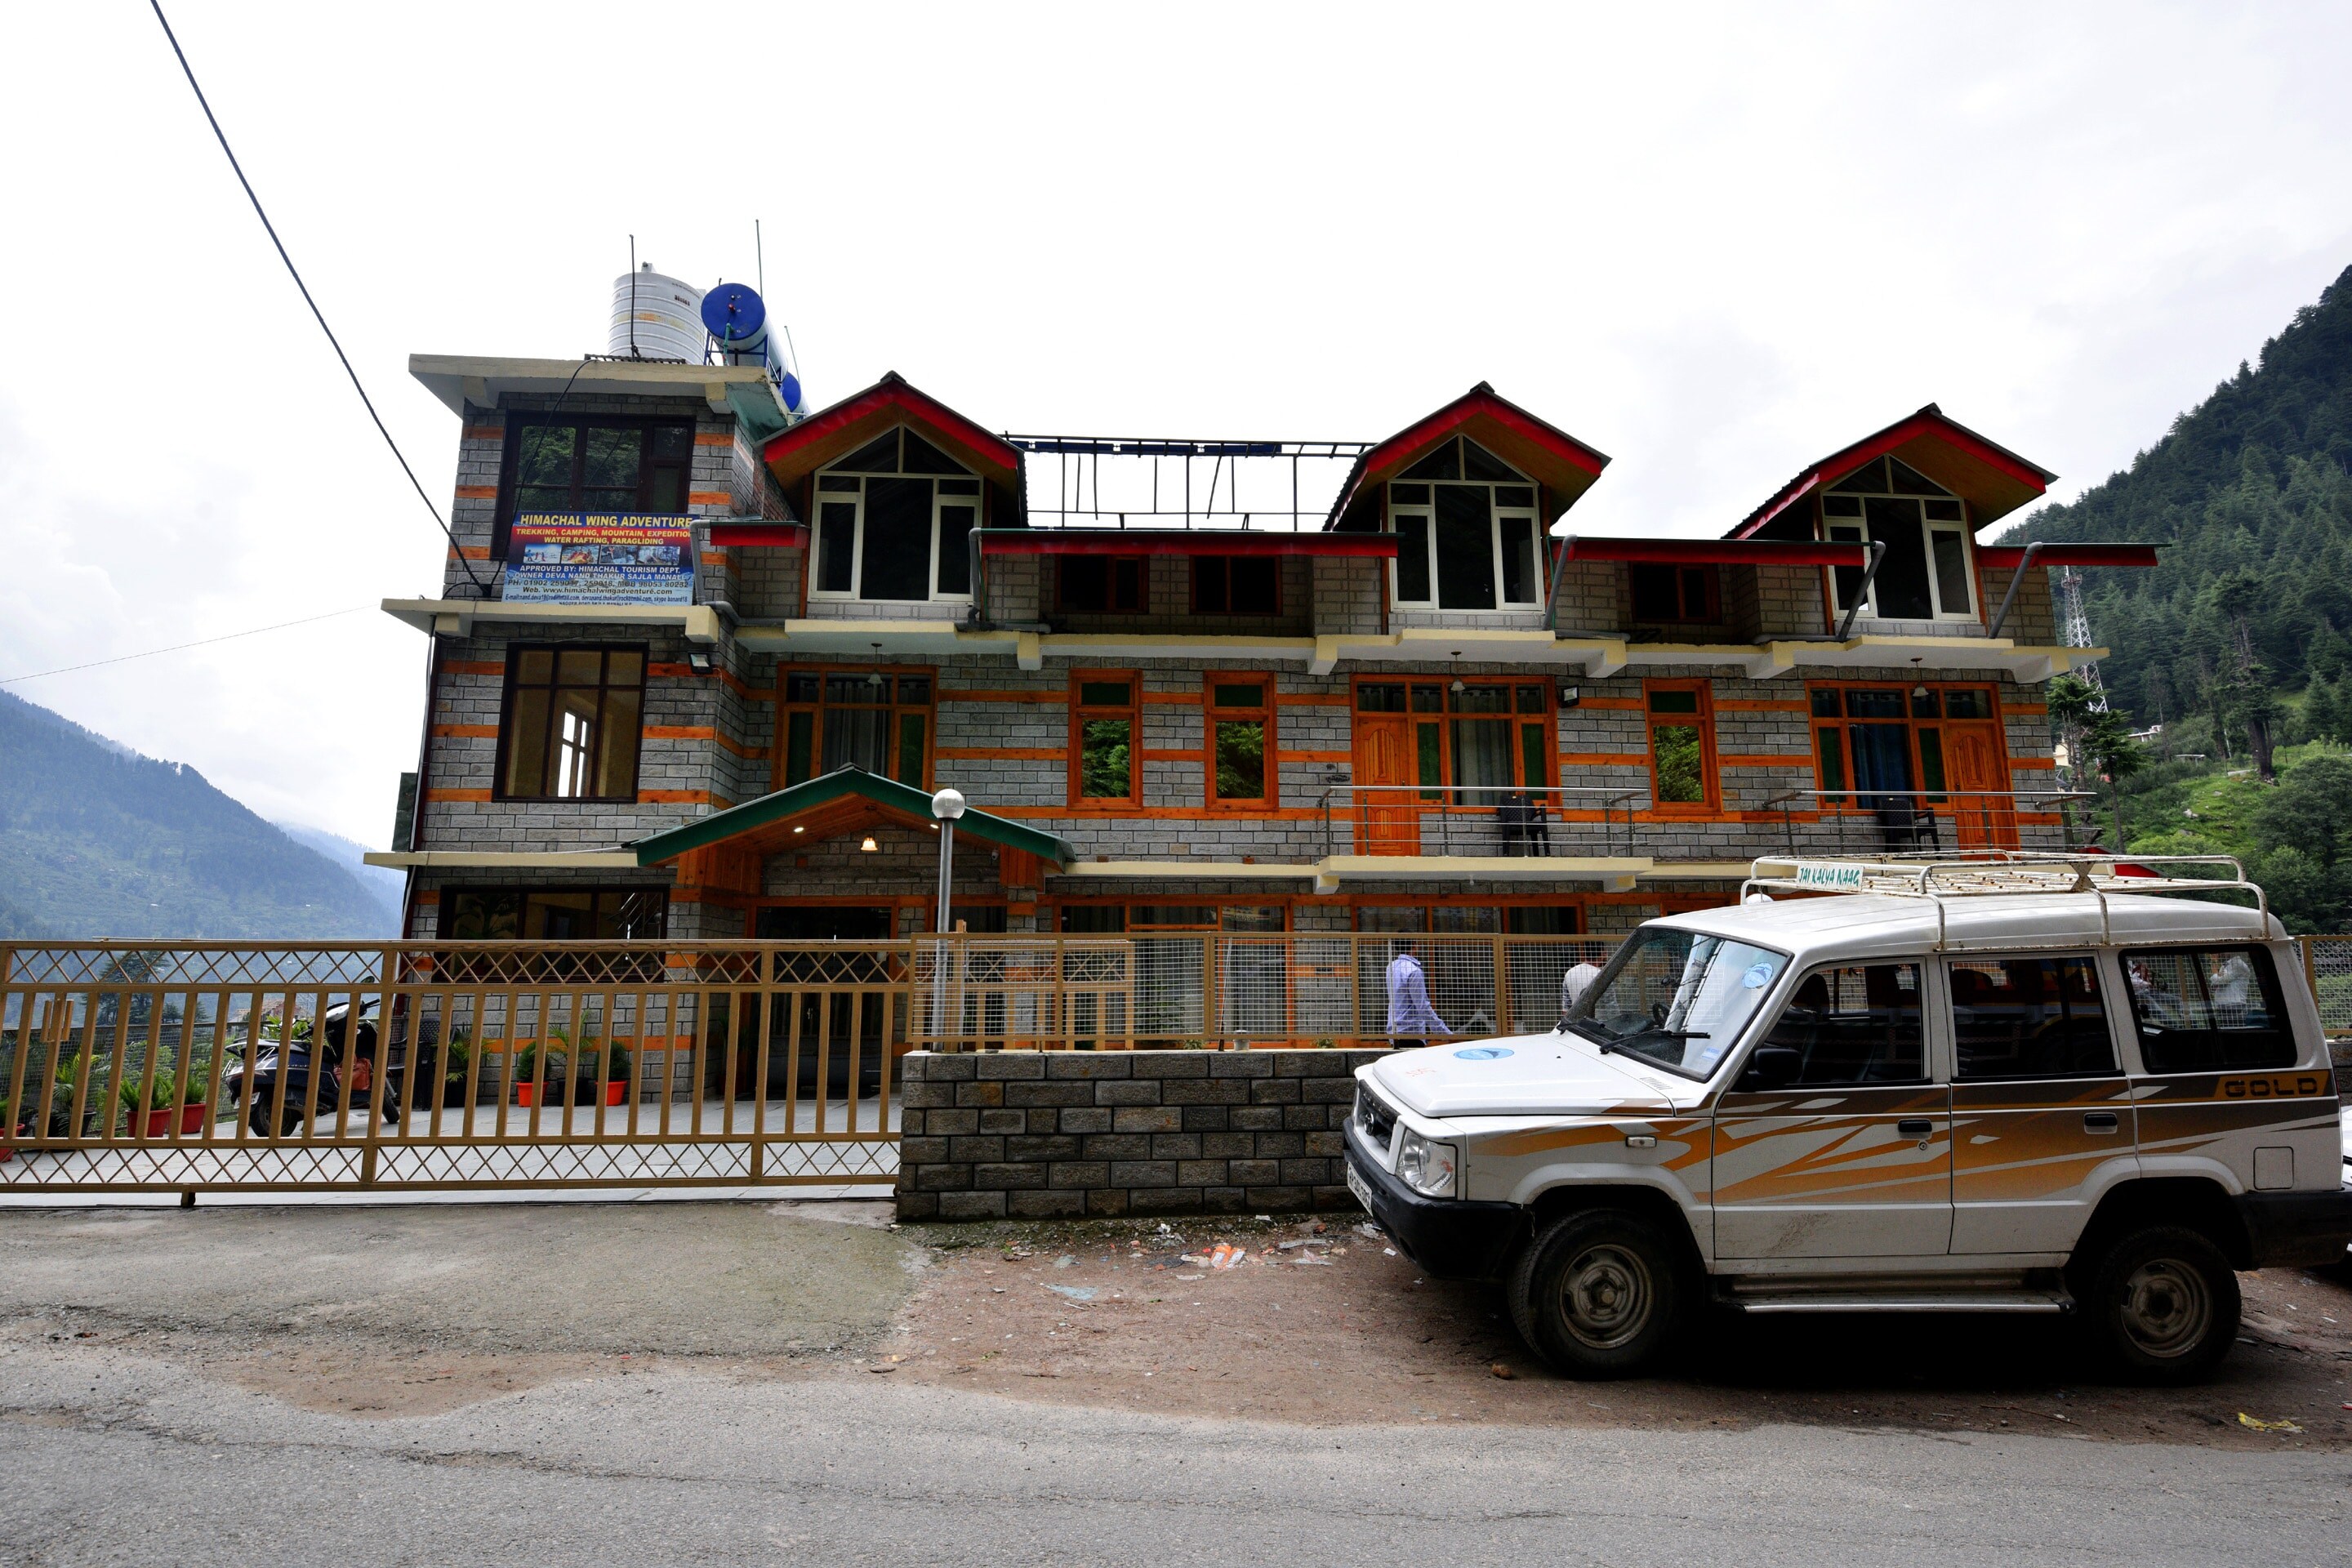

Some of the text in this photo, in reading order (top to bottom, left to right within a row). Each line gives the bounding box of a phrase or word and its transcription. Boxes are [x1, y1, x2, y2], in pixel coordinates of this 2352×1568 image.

[520, 515, 693, 528] HIMACHAL WING ADVENTURE
[573, 537, 609, 545] RAFTING,
[1799, 867, 1860, 887] JAI KALYA NAAG
[2224, 1077, 2318, 1098] GOLD
